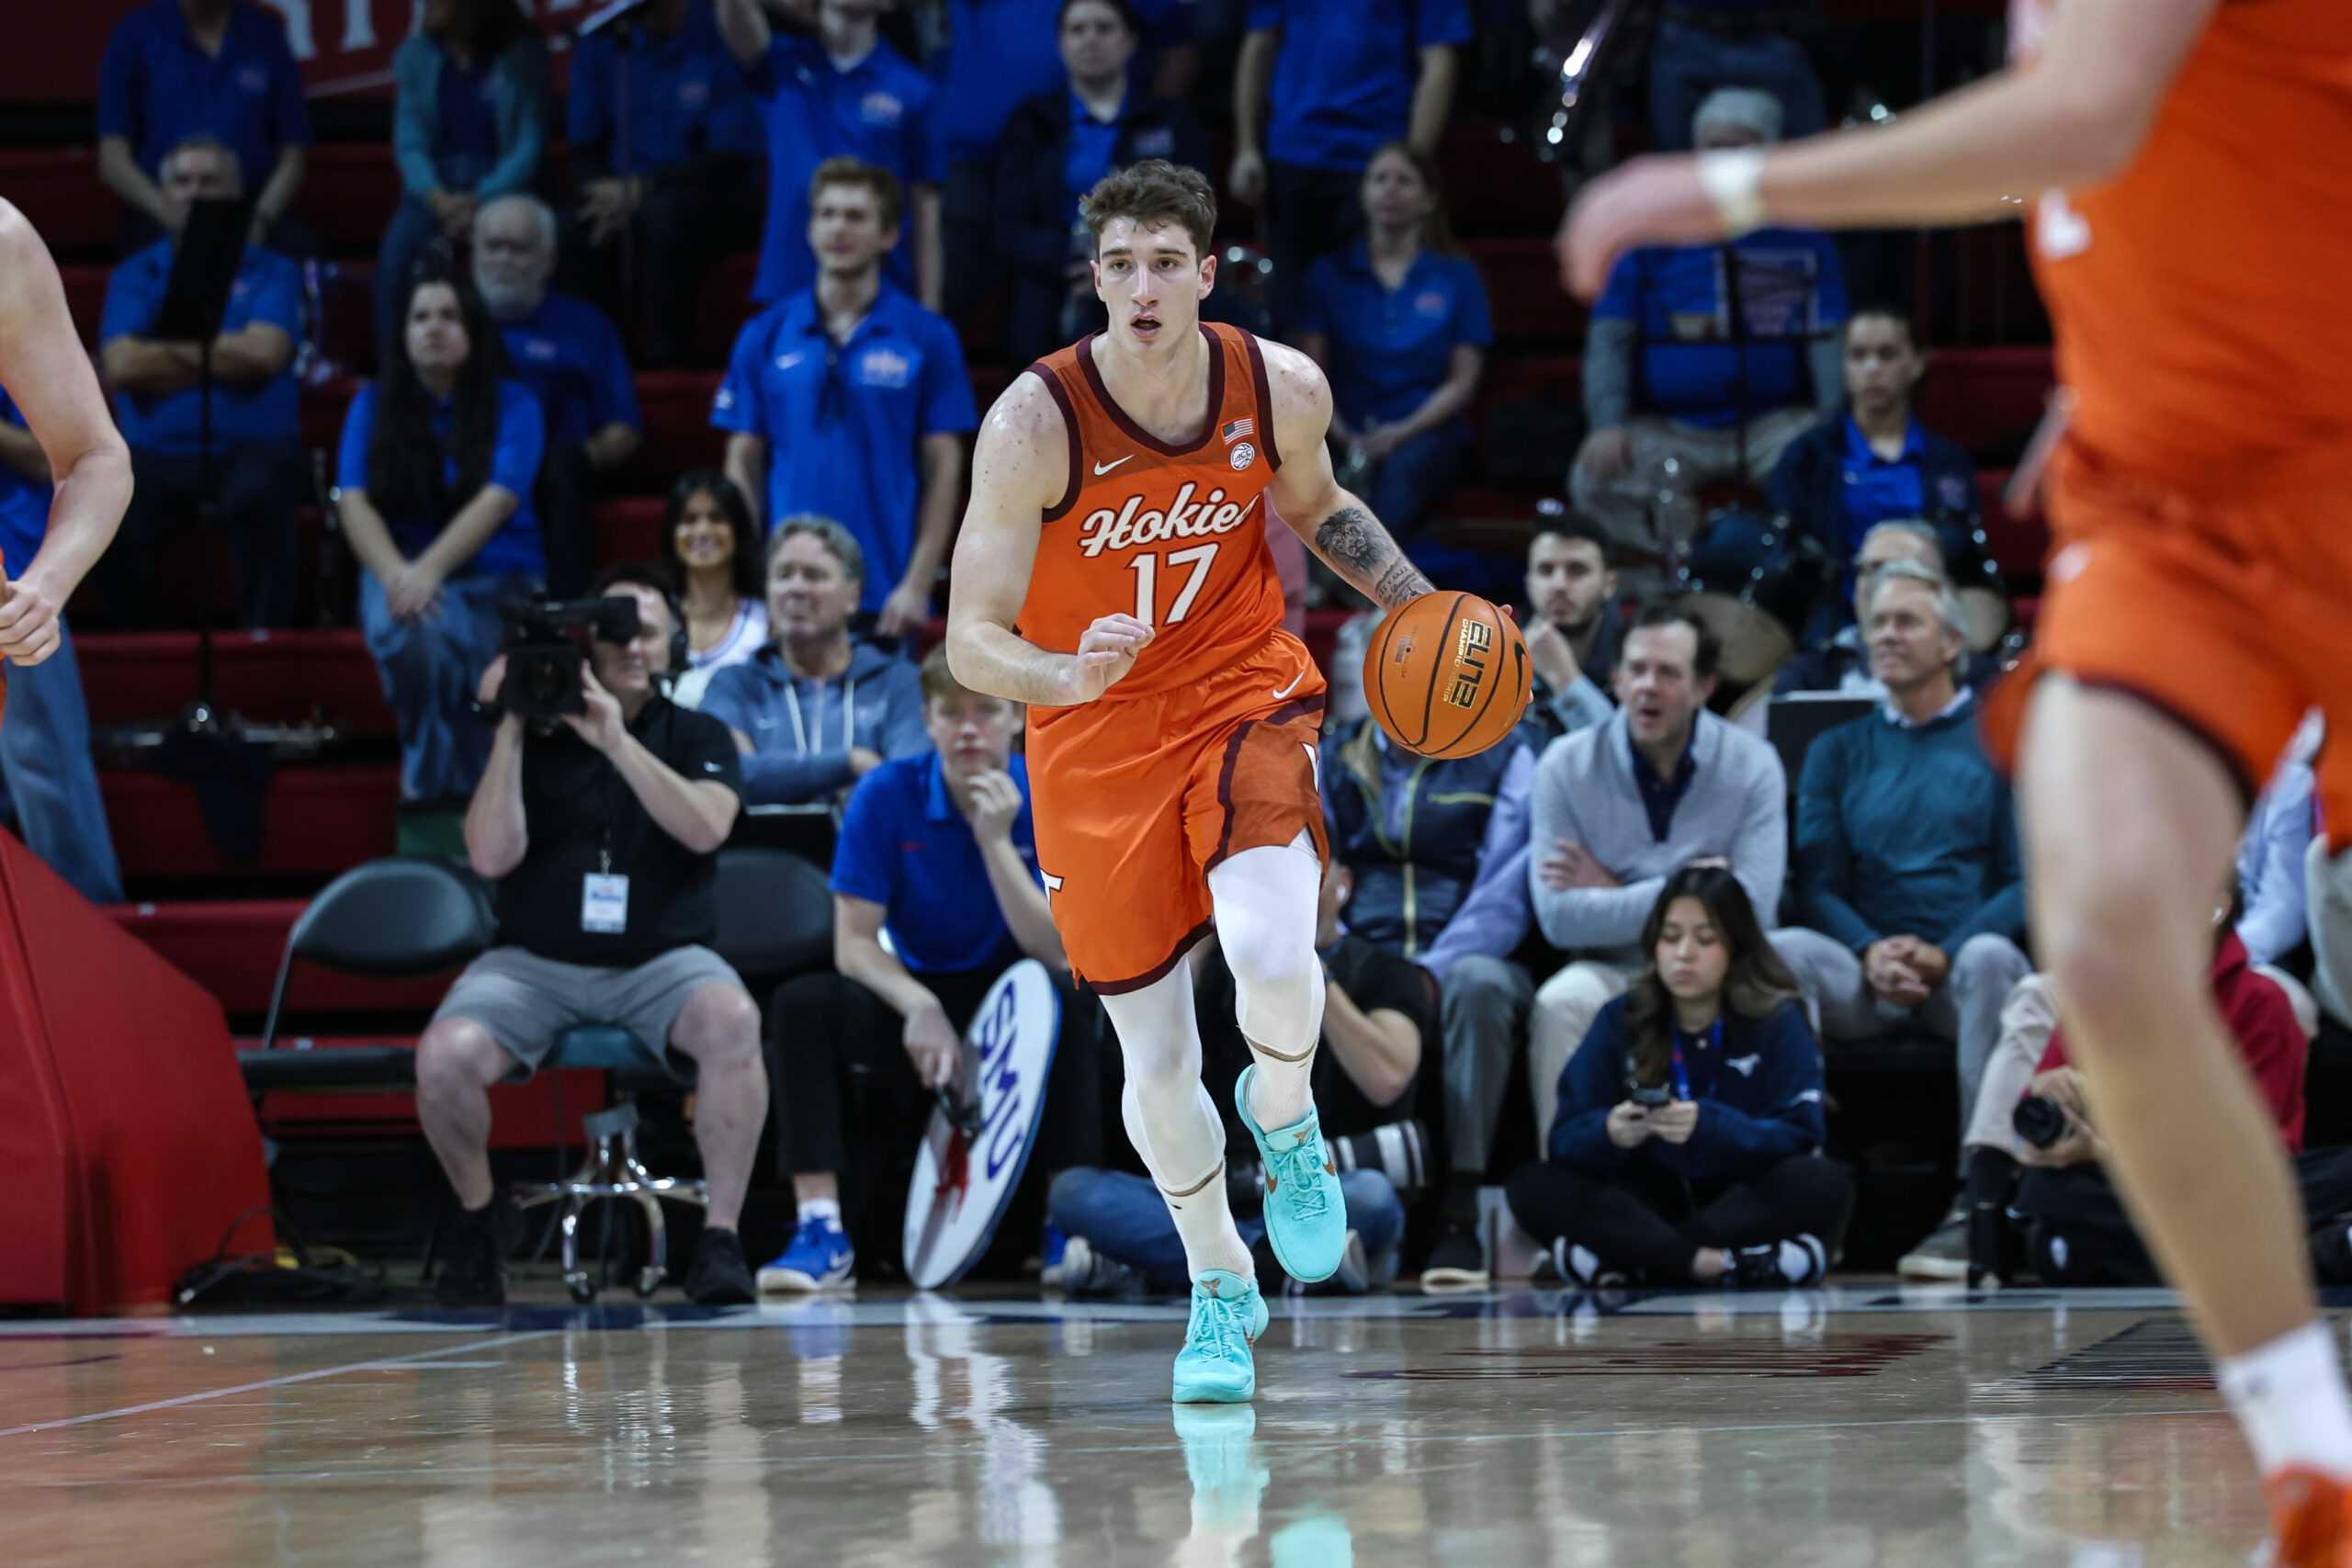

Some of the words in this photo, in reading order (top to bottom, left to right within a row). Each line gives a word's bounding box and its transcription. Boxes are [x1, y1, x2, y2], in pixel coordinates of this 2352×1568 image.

[1124, 541, 1221, 626] 17
[1442, 617, 1470, 703] CHAMPIOSHIP
[1449, 619, 1493, 710] ELITE
[981, 980, 1023, 1180] SMU
